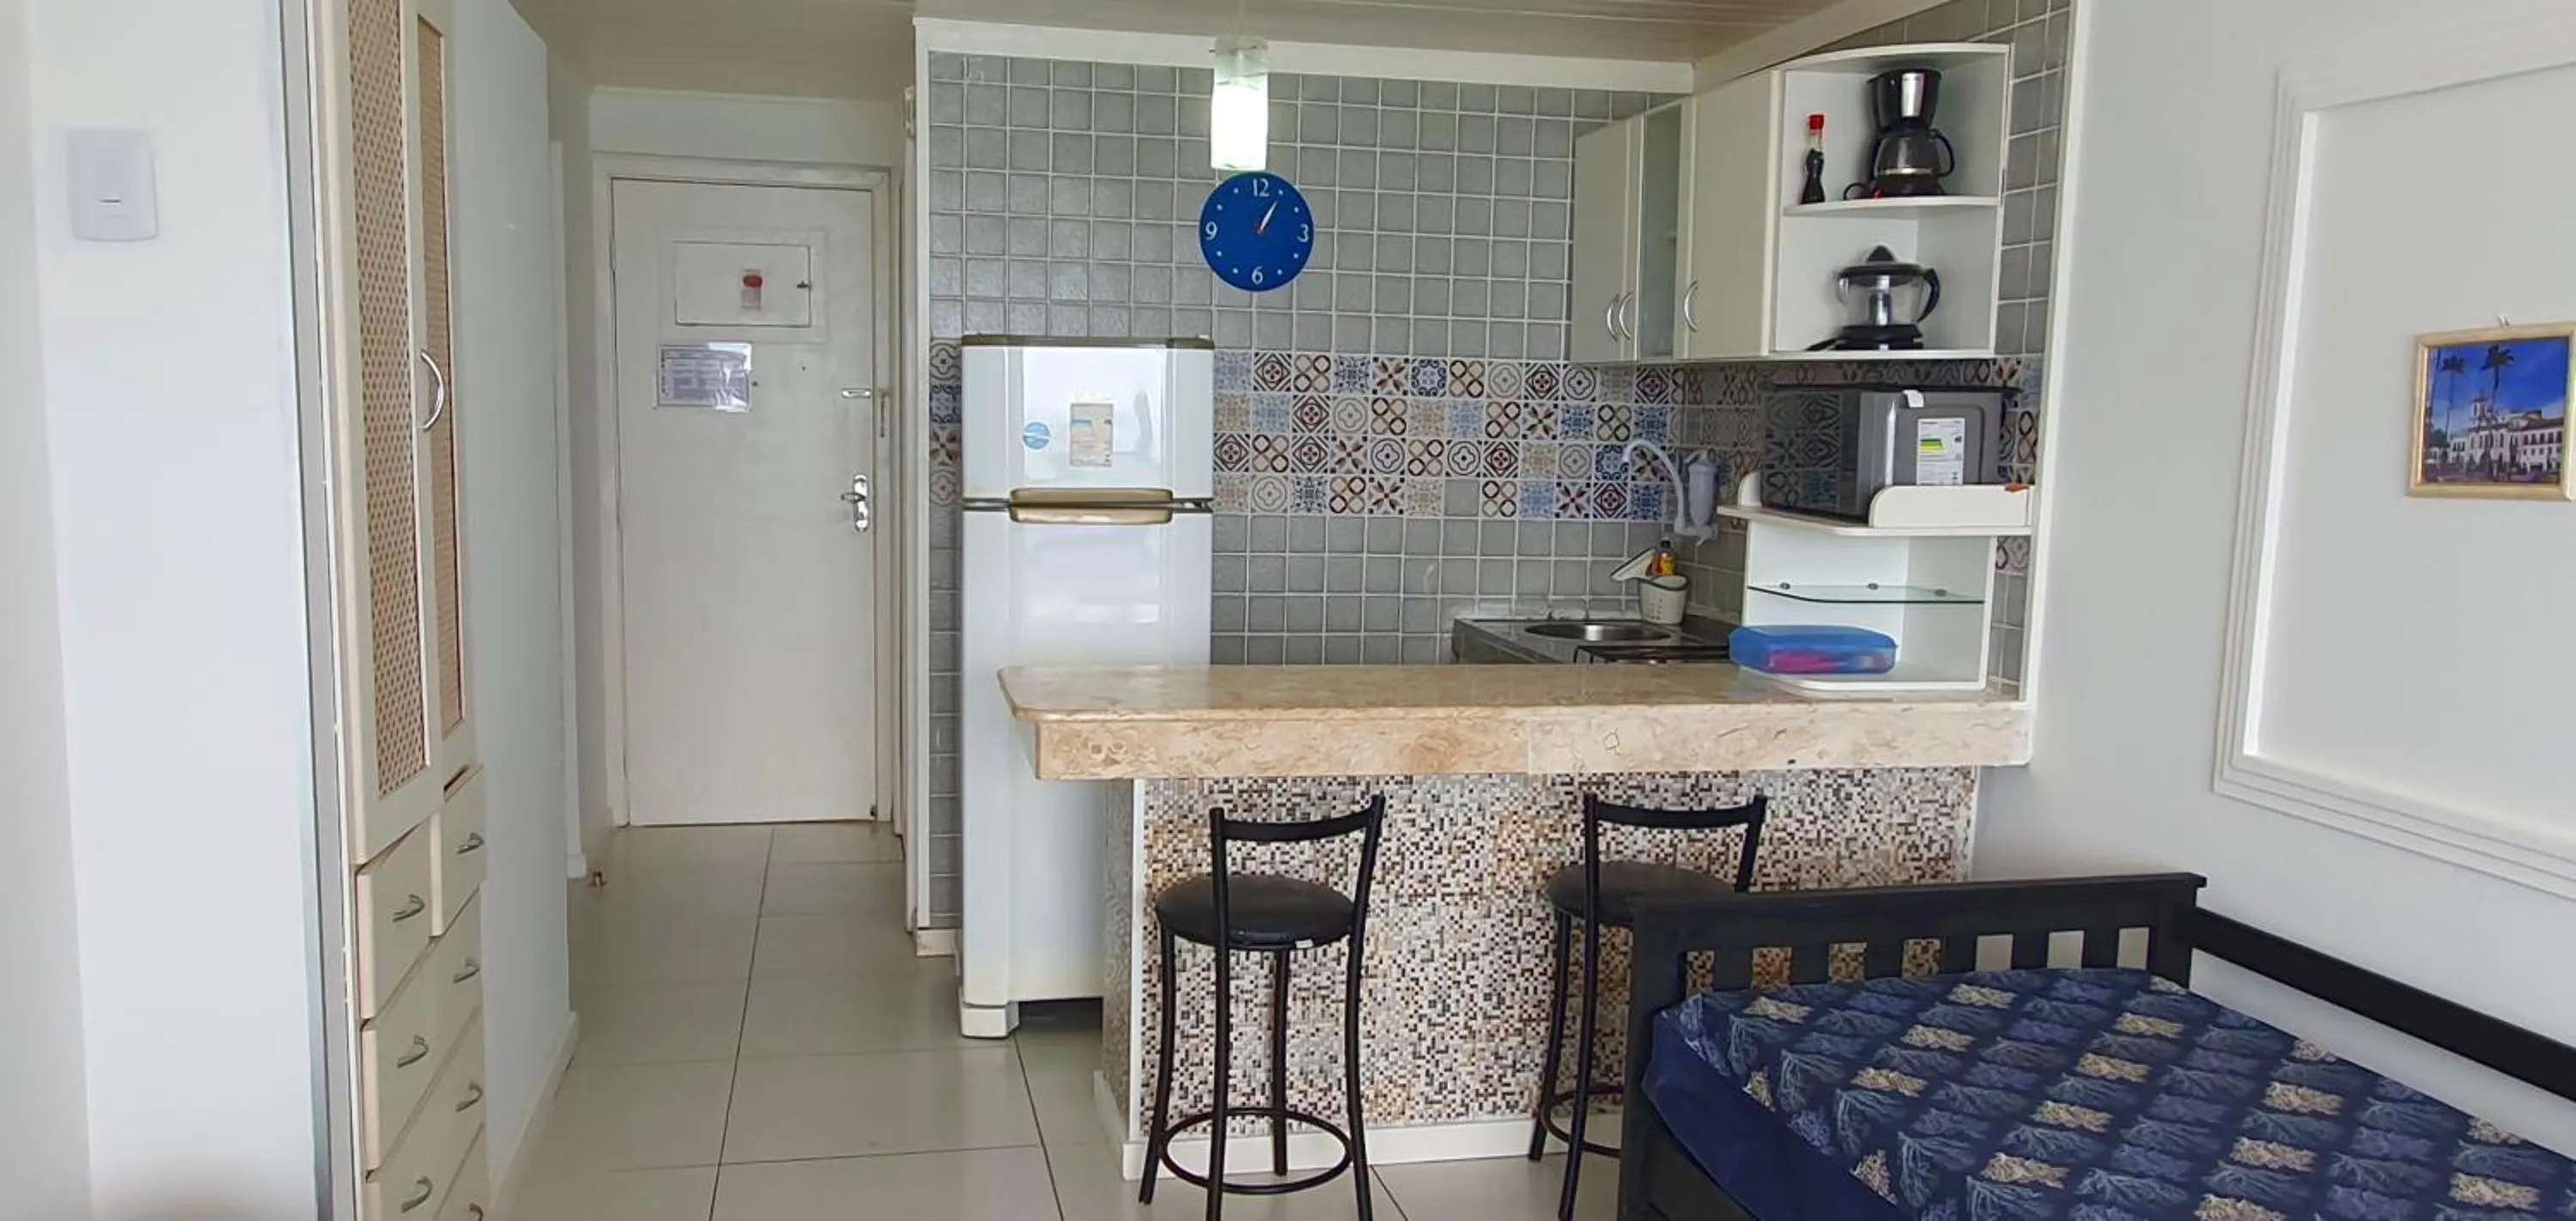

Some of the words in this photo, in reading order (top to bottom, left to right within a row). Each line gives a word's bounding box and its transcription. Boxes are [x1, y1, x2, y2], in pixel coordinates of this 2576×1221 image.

[1253, 178, 1271, 197] 12
[1205, 221, 1218, 240] 9
[1297, 223, 1309, 243] 3
[1251, 265, 1263, 284] 6
